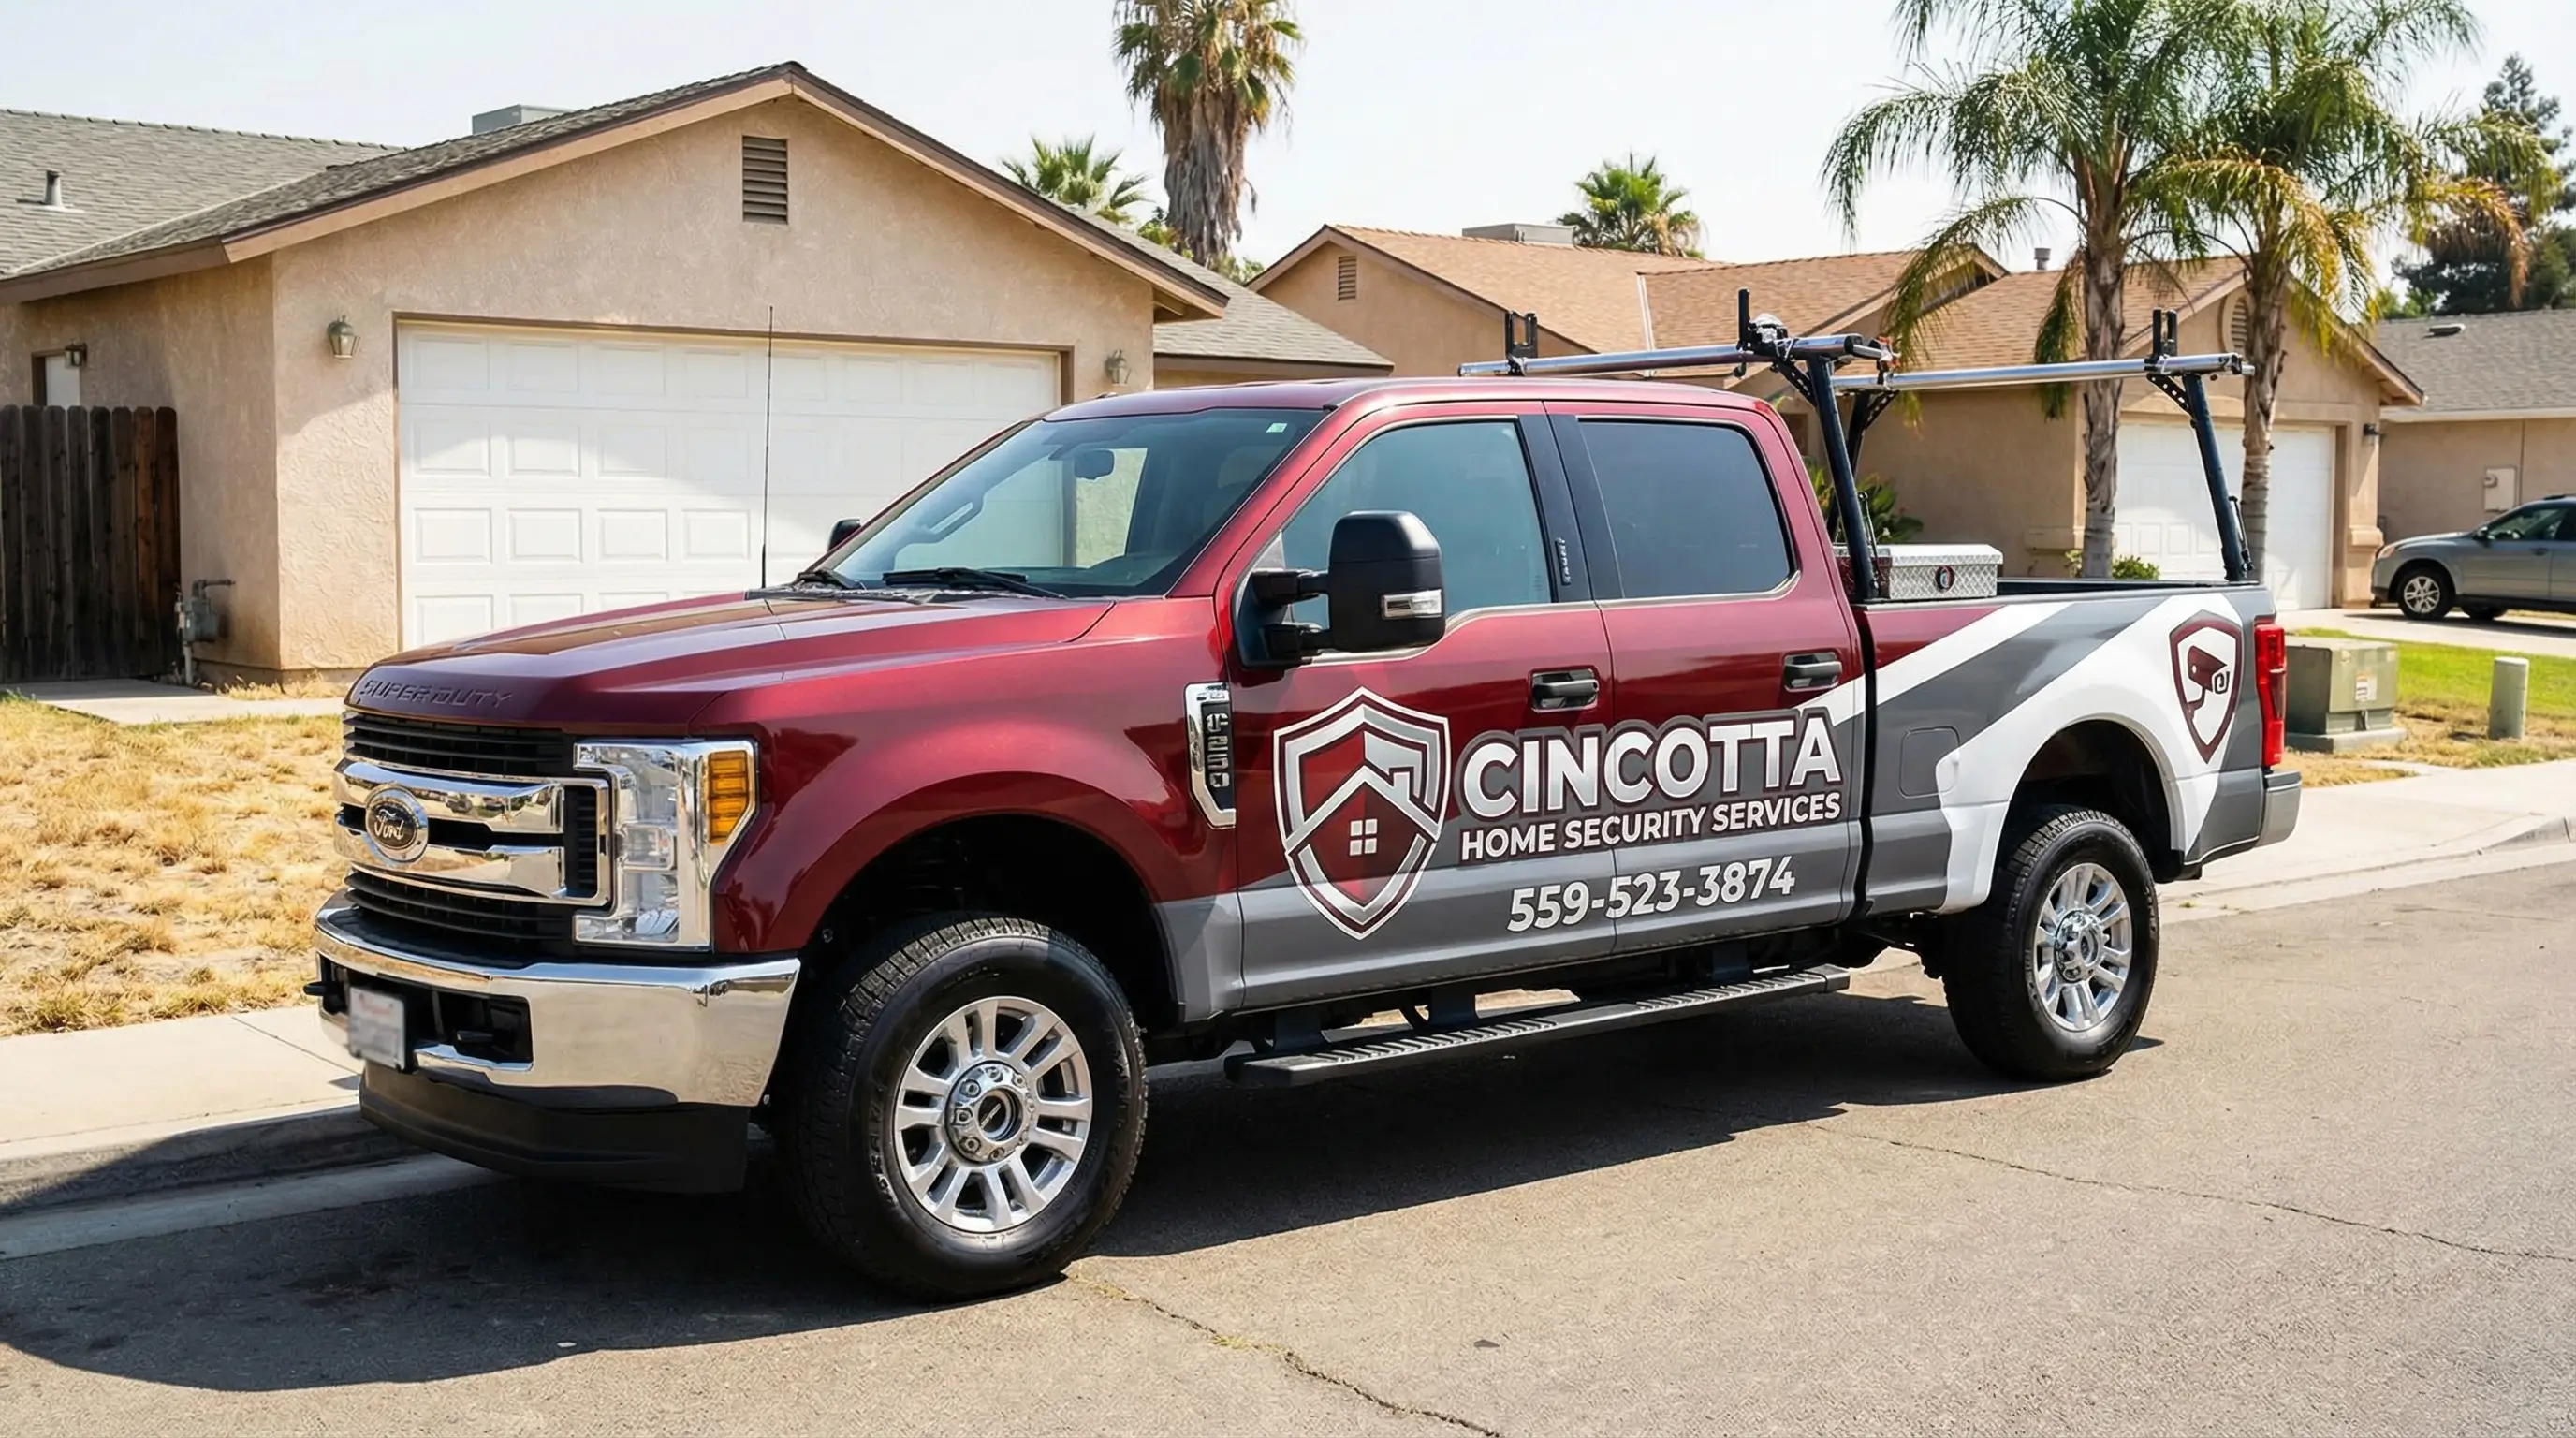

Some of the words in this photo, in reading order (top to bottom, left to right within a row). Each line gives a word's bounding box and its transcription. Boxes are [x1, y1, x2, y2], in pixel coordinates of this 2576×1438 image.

[360, 680, 432, 702] SUPER
[432, 687, 513, 708] DUTY
[1463, 717, 1842, 818] CINCOTTA
[1461, 825, 1556, 860] HOME
[1564, 805, 1708, 849] SECURITY
[1711, 792, 1841, 831] SERVICES
[1507, 856, 1795, 932] 559-523-3874
